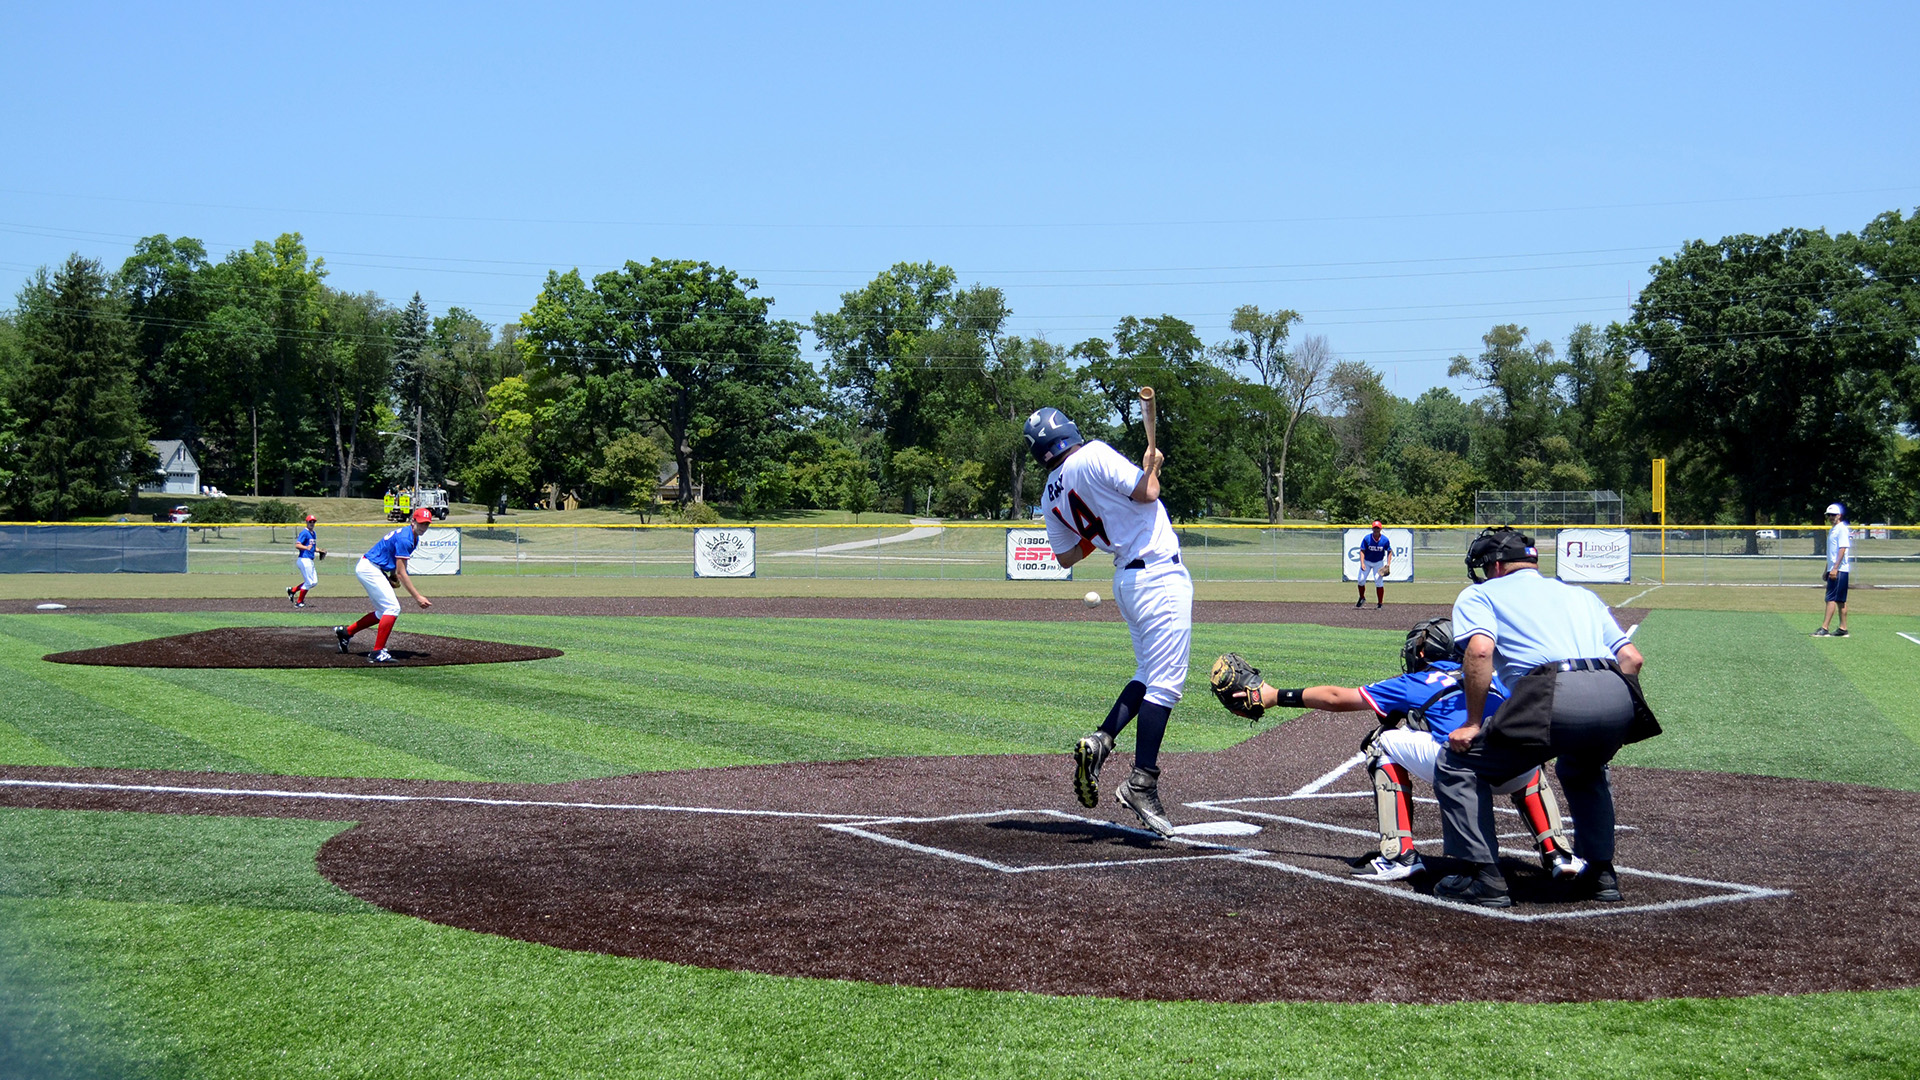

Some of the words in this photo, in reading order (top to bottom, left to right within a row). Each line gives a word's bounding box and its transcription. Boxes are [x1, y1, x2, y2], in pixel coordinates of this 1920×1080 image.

[705, 532, 745, 550] HARLOW
[1023, 537, 1045, 545] 1380
[1584, 541, 1620, 552] Lincoln
[708, 558, 741, 573] CORPORATION
